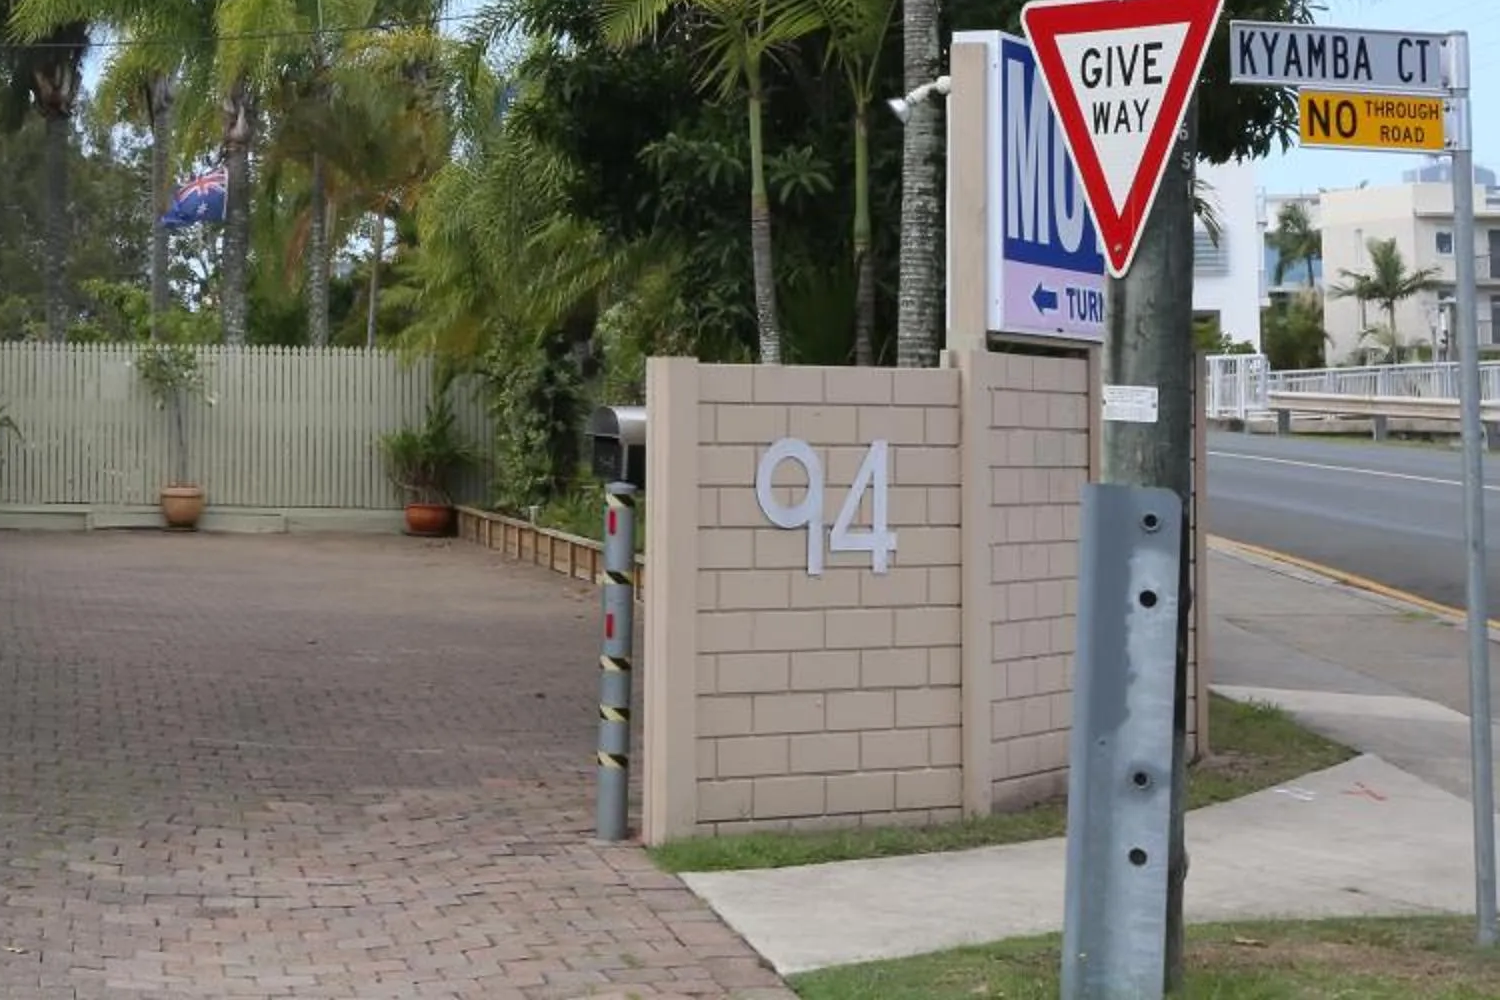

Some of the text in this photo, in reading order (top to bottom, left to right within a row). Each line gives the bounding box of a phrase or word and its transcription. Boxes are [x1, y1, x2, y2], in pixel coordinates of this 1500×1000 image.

[1080, 41, 1164, 89] GIVE
[1238, 29, 1431, 84] KYAMBA CT
[1092, 99, 1150, 135] WAY
[1307, 98, 1358, 139] NO
[1364, 100, 1440, 121] THROUGH
[1379, 124, 1426, 144] ROAD
[755, 436, 898, 577] 94
